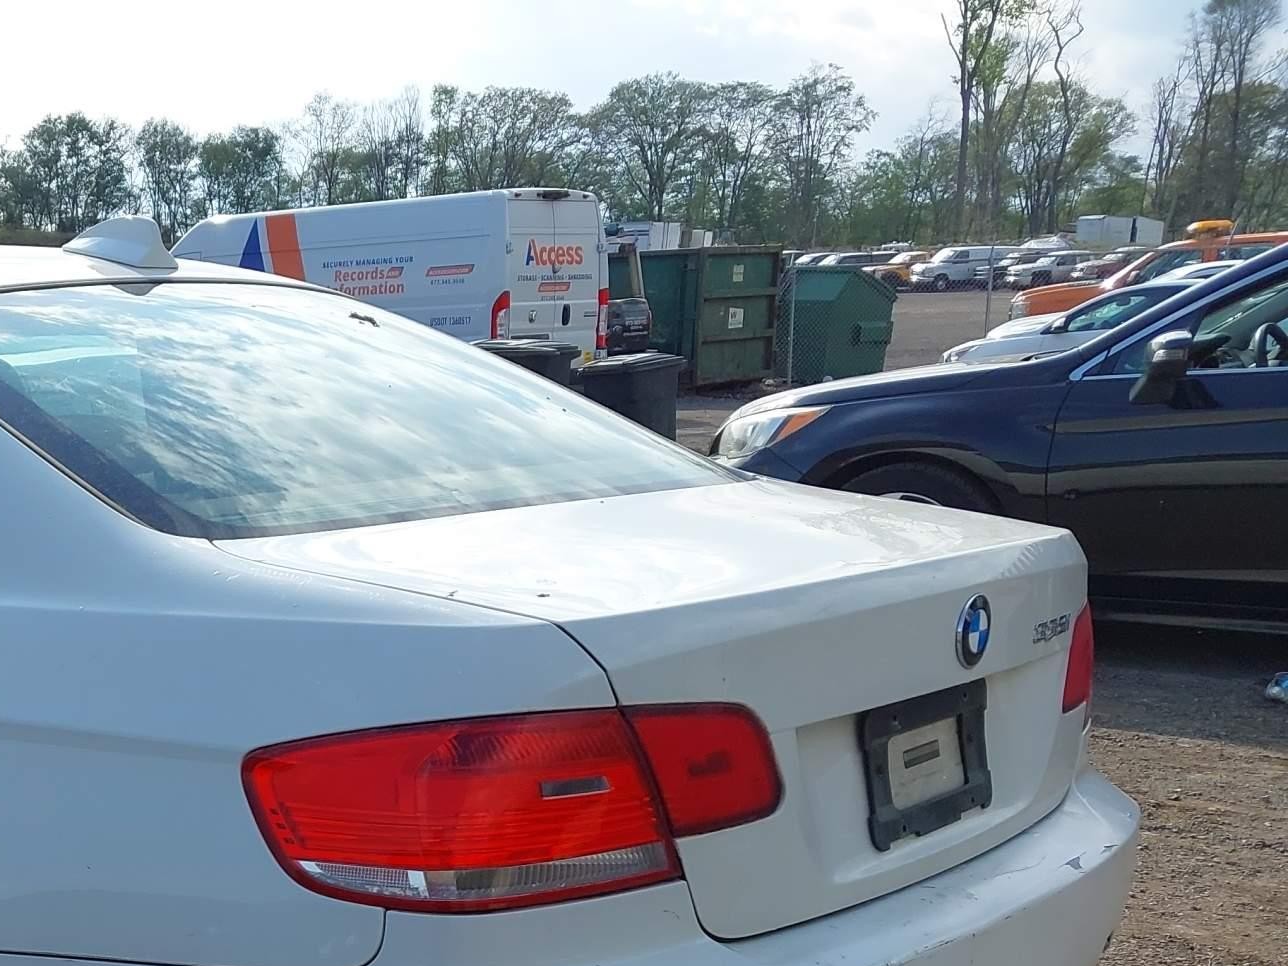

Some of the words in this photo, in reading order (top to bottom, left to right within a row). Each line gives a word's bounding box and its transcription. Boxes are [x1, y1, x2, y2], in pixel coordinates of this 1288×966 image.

[526, 239, 583, 266] Access
[322, 259, 354, 269] SECURELY
[355, 257, 393, 267] MANAGING
[395, 256, 414, 264] YOUR
[334, 266, 385, 283] Records
